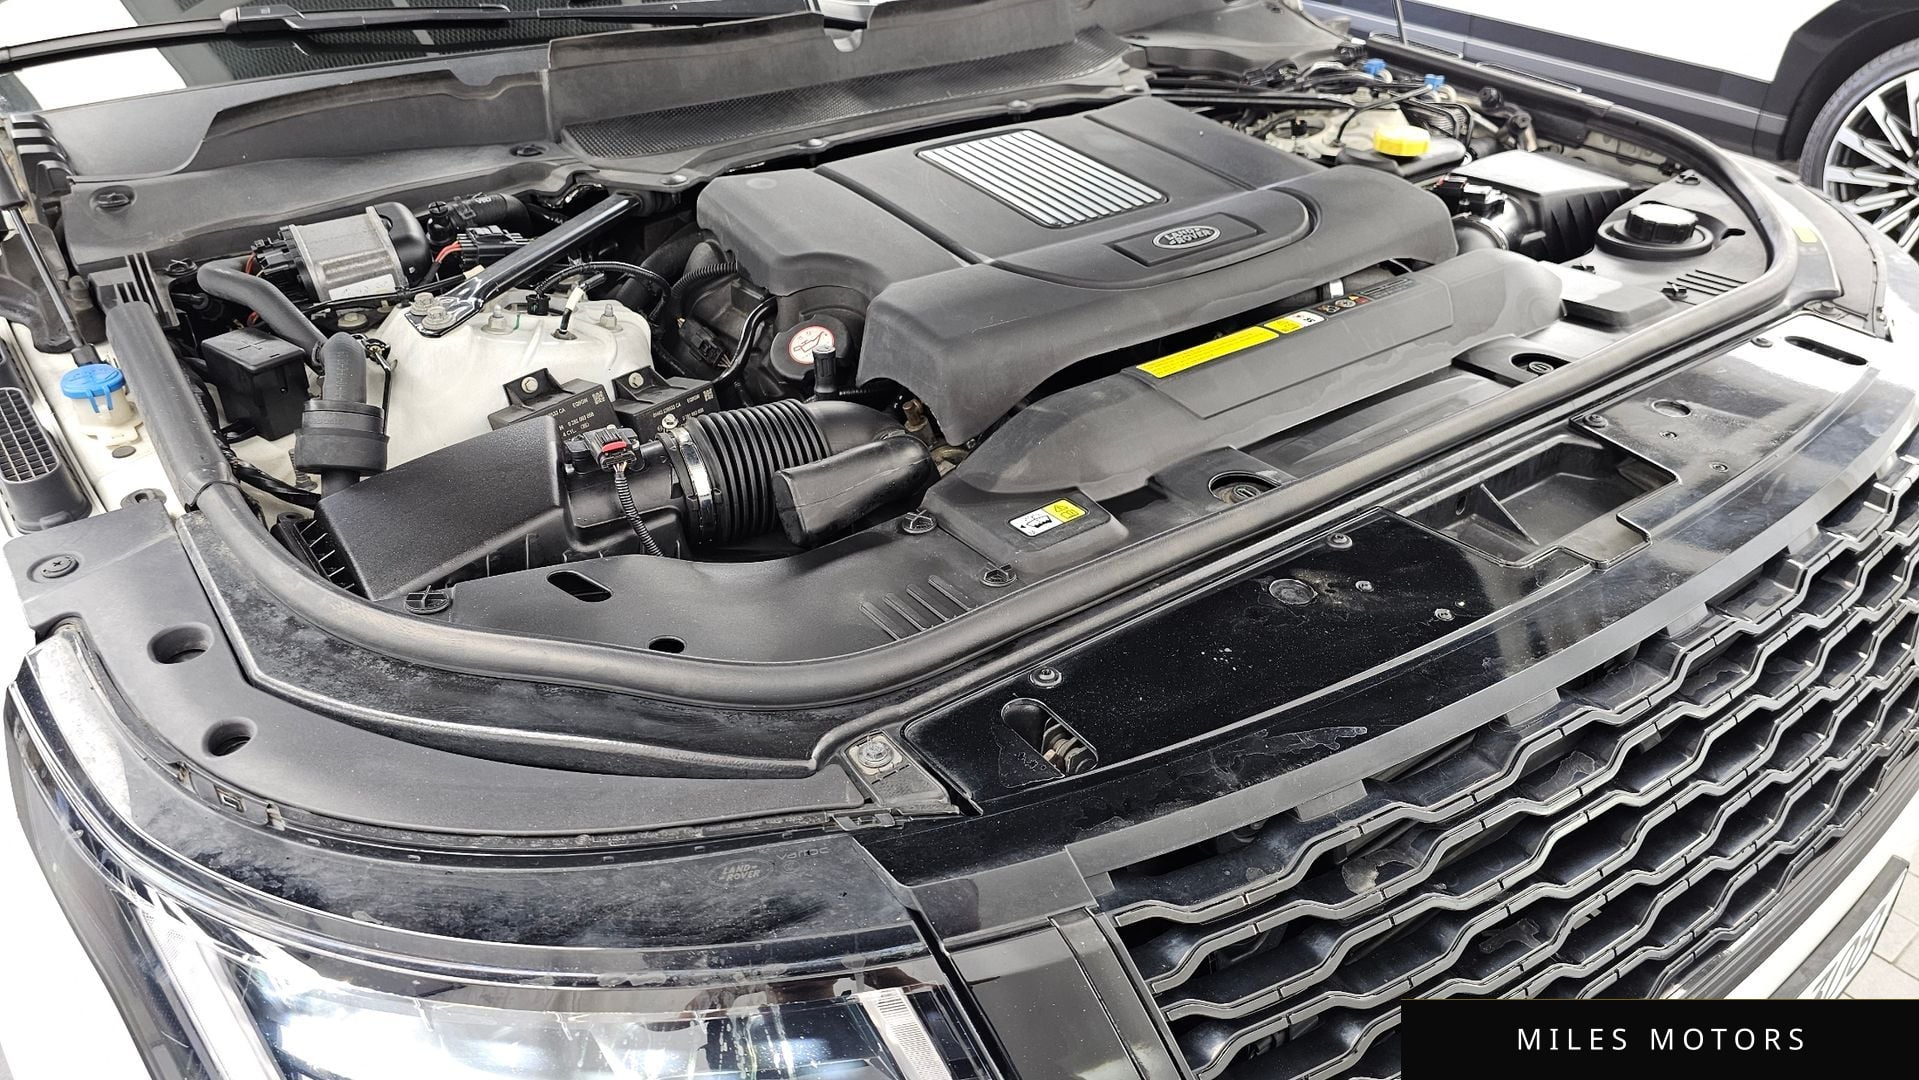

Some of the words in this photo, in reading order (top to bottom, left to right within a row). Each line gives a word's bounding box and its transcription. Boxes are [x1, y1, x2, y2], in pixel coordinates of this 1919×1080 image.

[1164, 228, 1198, 241] LAND
[1175, 229, 1213, 244] ROVER
[722, 864, 752, 875] LAND
[726, 869, 761, 882] ROVER
